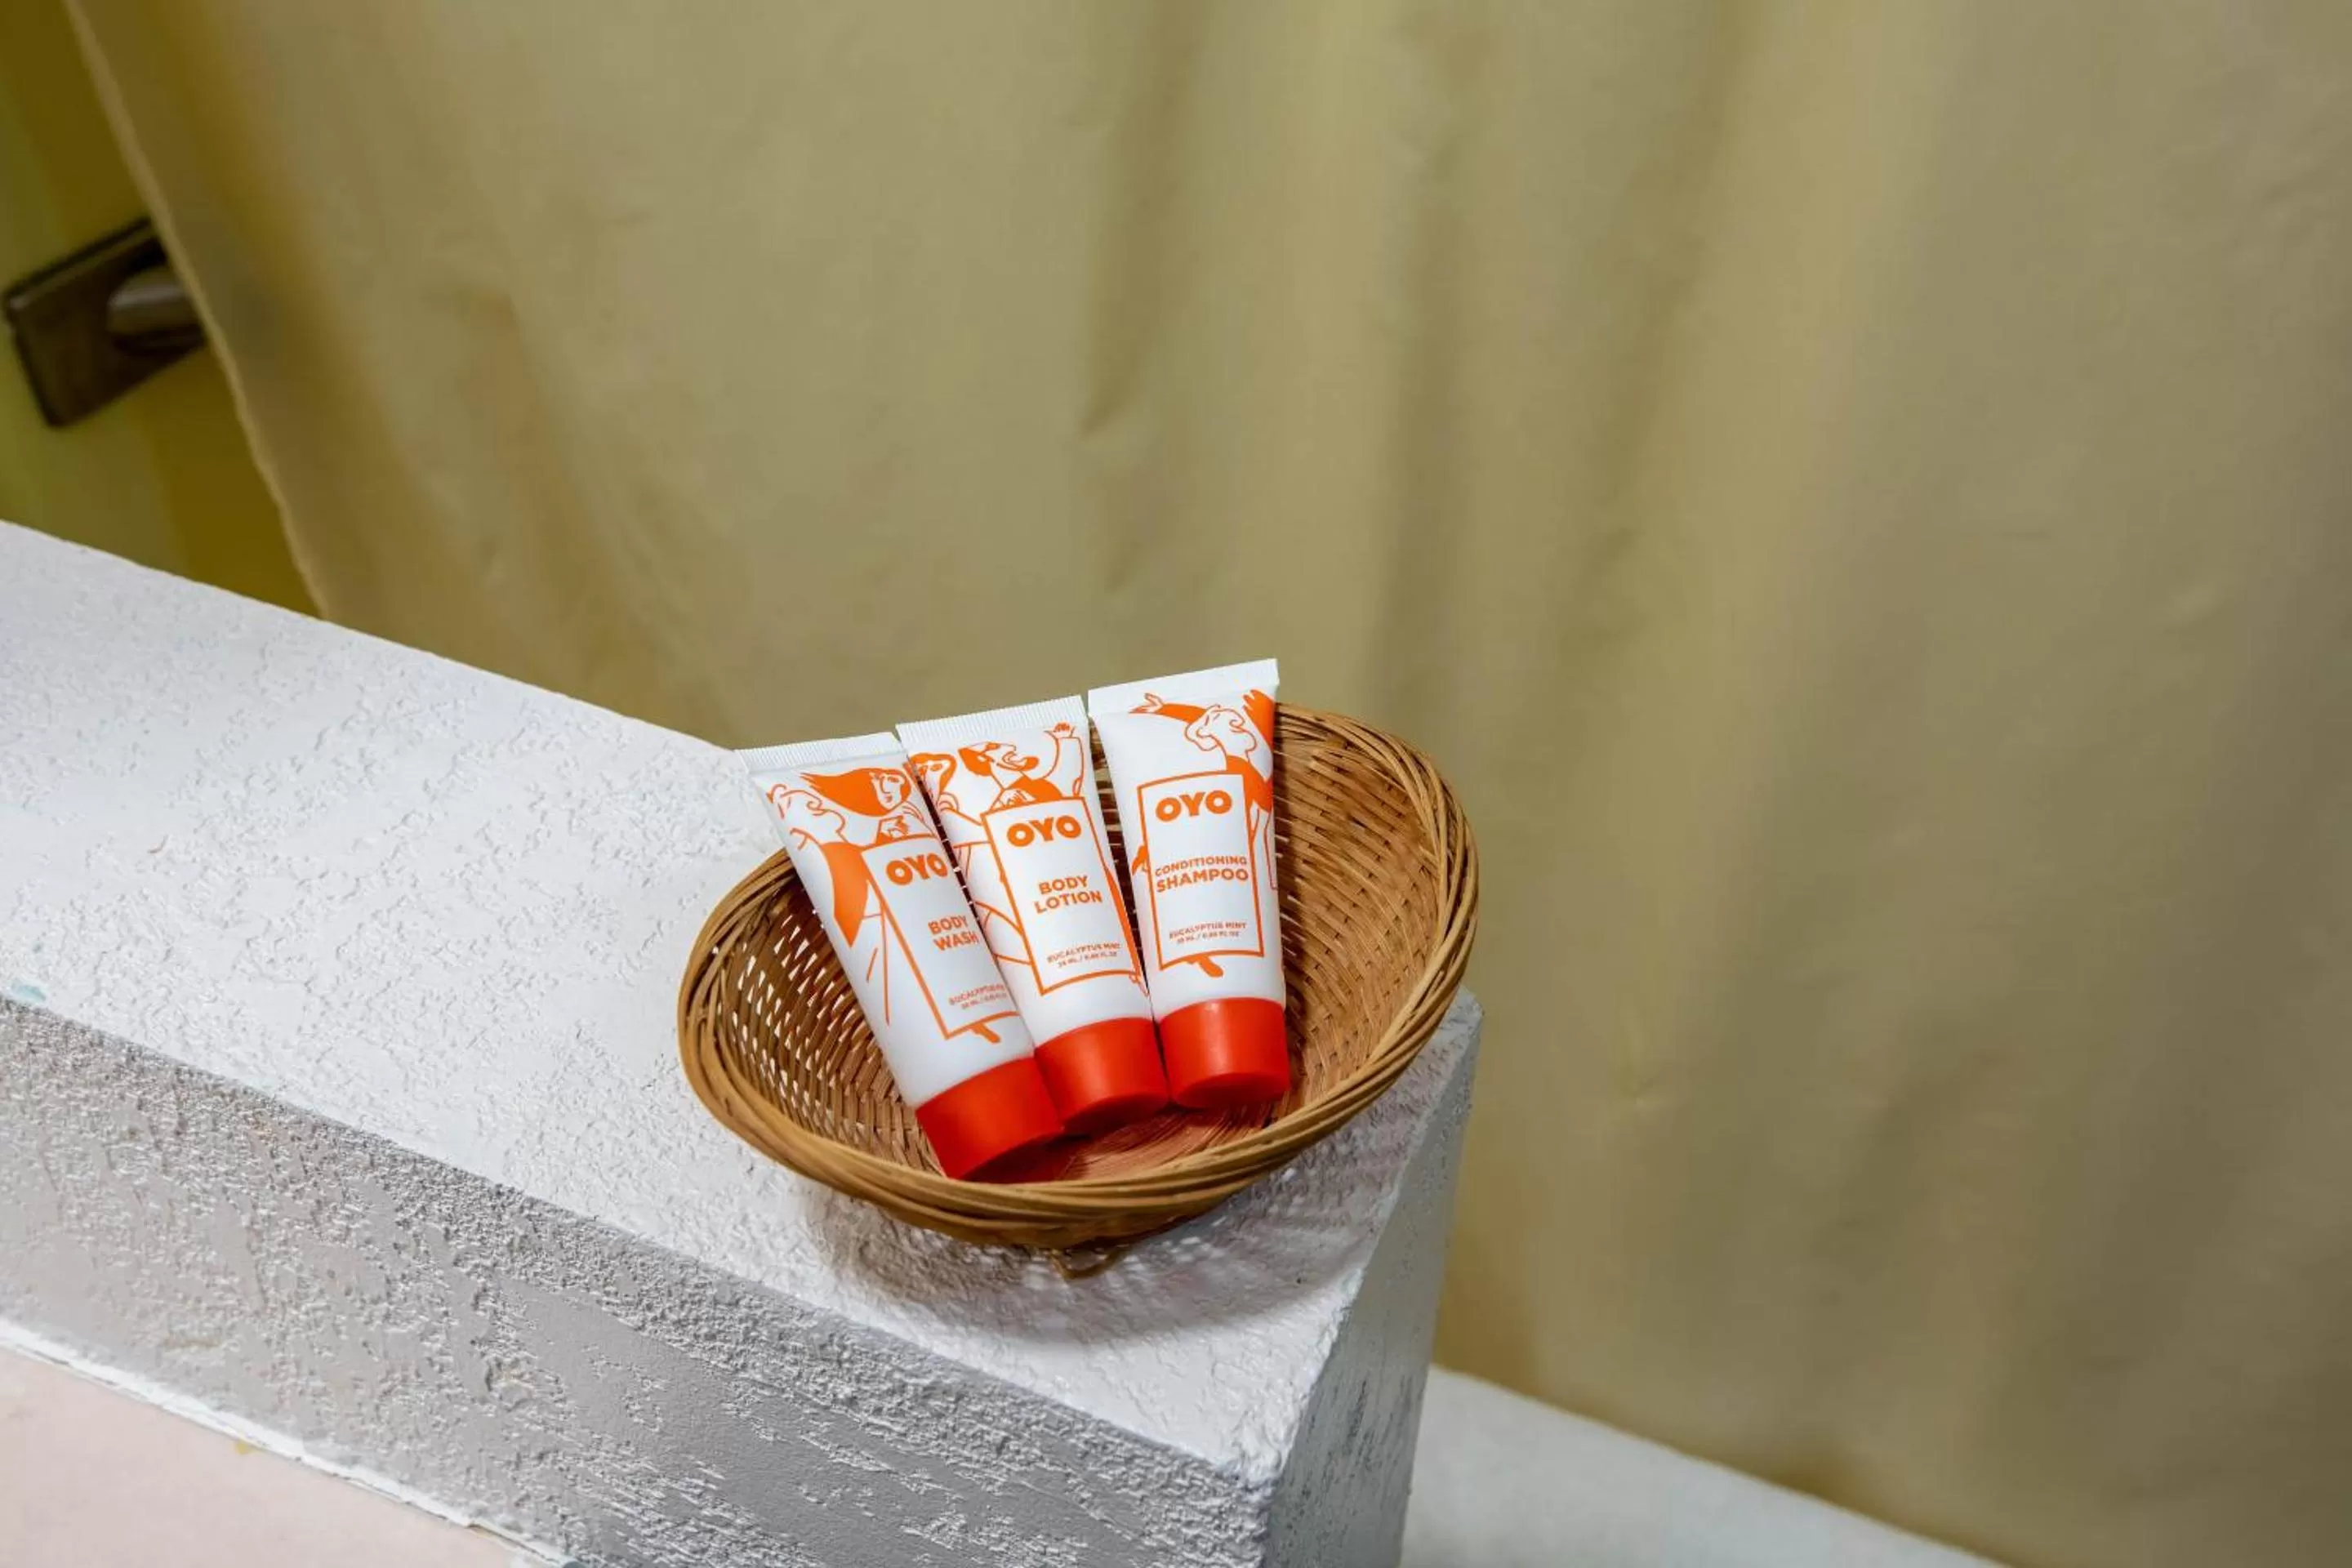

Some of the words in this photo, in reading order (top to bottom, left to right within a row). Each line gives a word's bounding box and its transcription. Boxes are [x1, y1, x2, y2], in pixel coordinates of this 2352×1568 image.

[1156, 790, 1232, 822] OYO
[1006, 815, 1082, 847] OYO
[885, 853, 948, 885] OYO
[1155, 856, 1248, 876] CONDITIONING
[1038, 875, 1088, 894] BODY
[1156, 868, 1249, 893] SHAMPOO
[1034, 891, 1102, 913] LOTION
[928, 915, 968, 935] BODY
[933, 931, 979, 951] WASH
